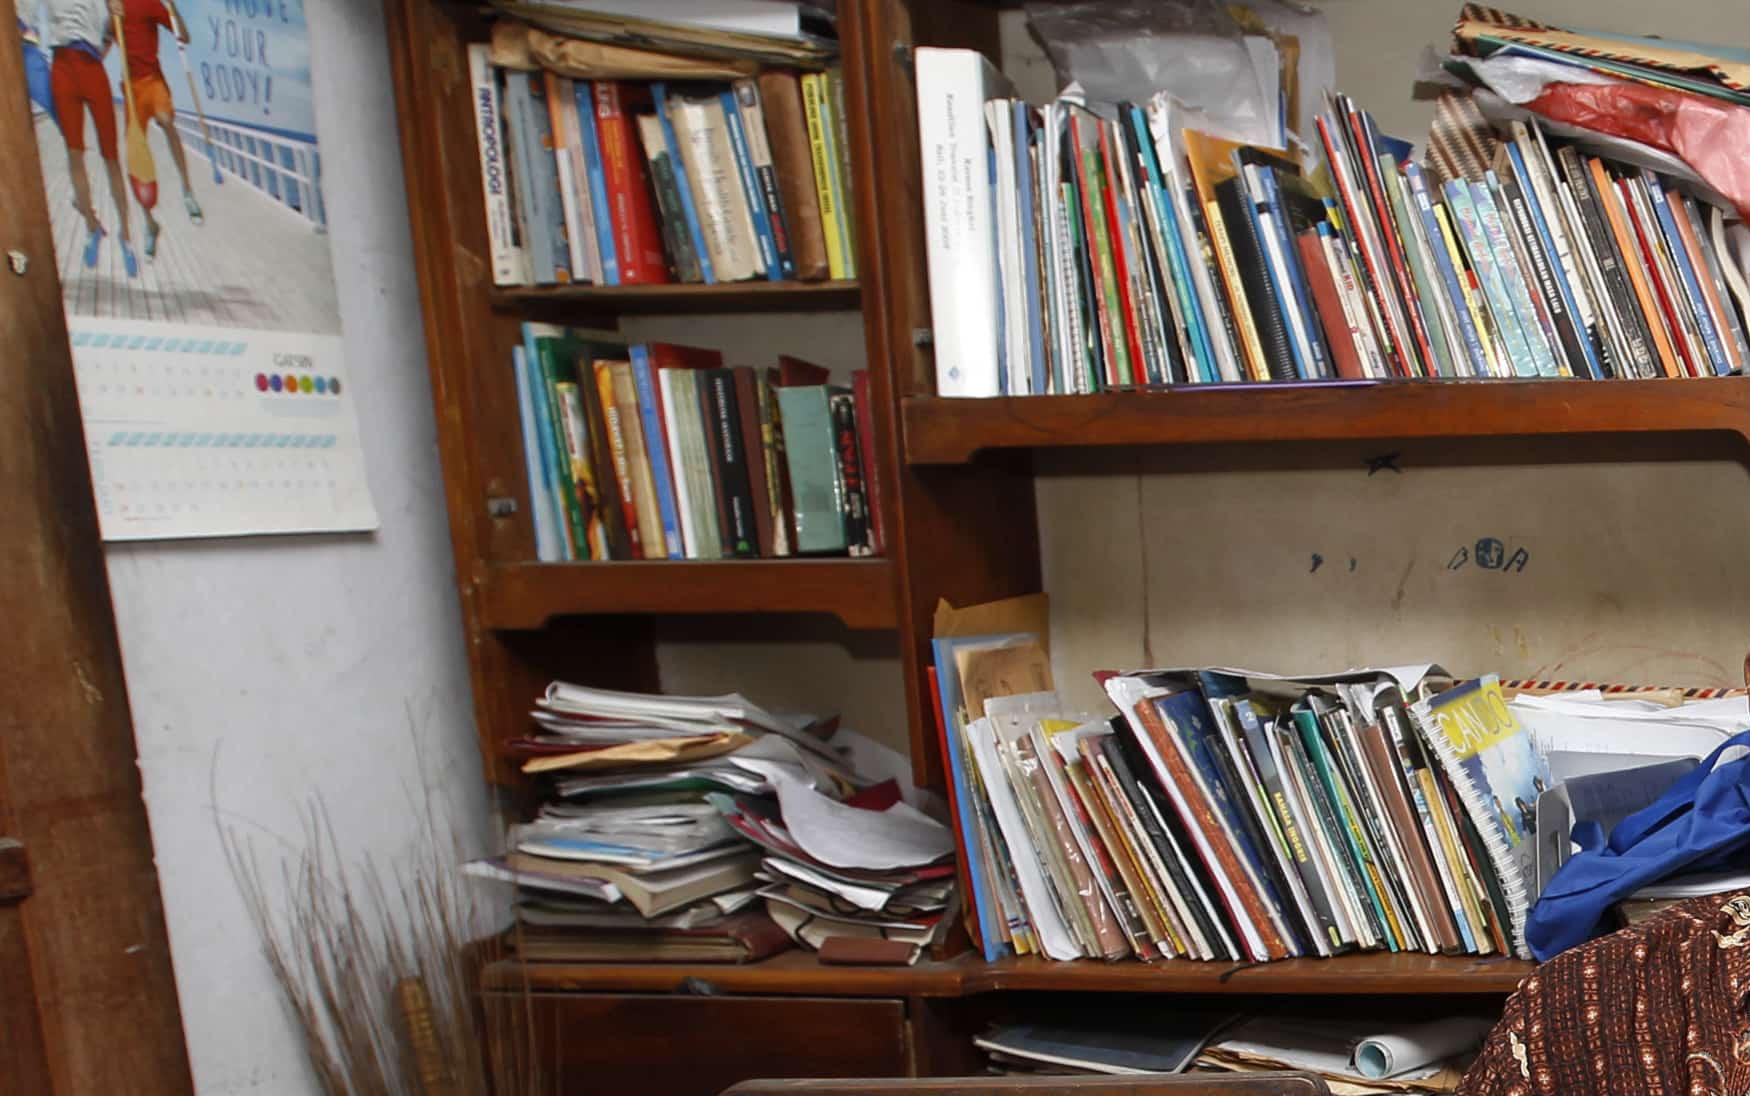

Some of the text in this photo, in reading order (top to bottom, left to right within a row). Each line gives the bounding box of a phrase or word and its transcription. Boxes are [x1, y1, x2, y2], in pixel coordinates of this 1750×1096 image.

[208, 15, 267, 66] YOUR
[200, 61, 272, 116] BODY!
[479, 87, 503, 195] ANTROPOLOGI
[1273, 791, 1308, 864] BAHASA INGGRIS
